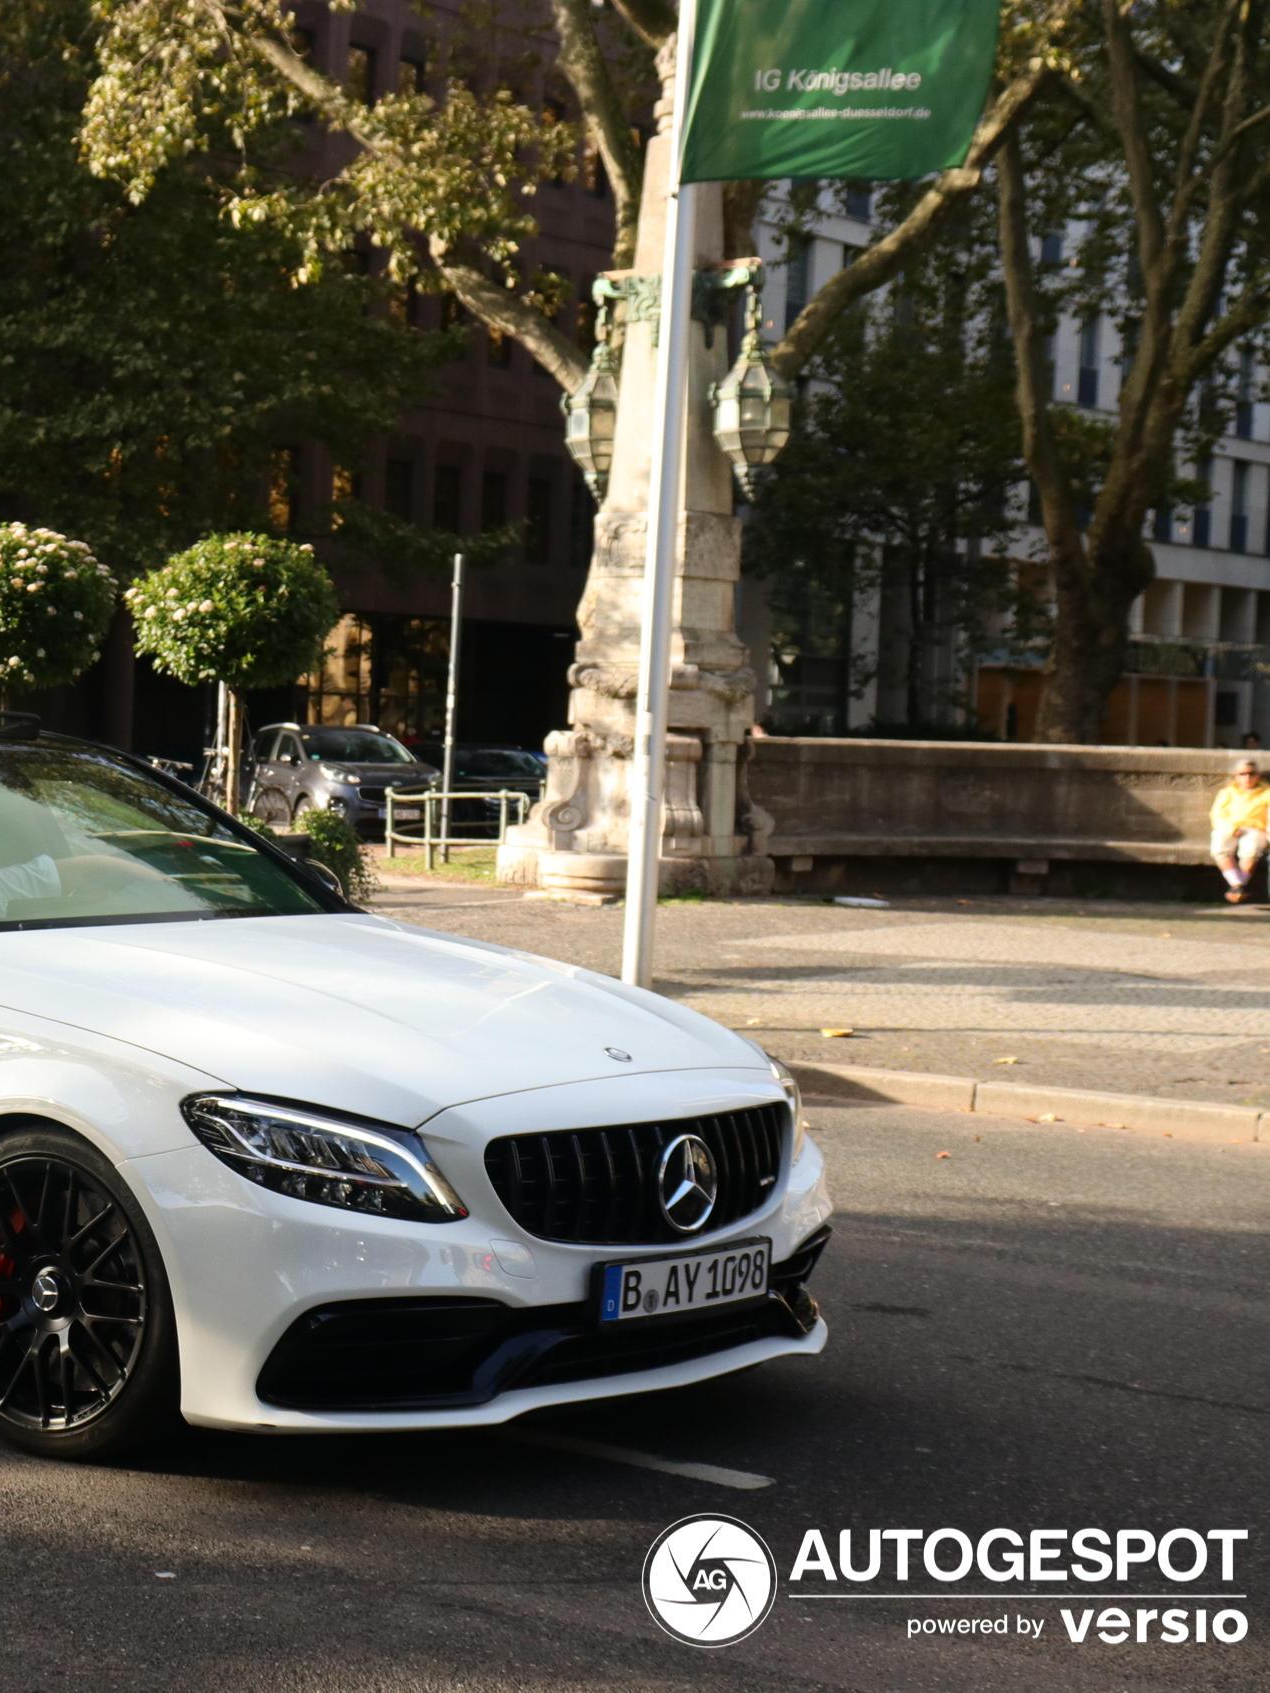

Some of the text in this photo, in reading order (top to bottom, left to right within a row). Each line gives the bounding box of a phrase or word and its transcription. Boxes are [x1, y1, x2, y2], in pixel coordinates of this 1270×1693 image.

[754, 67, 922, 96] IG Königsallee
[740, 106, 932, 121] www.koenigsallee-duesseldorf.de
[622, 1249, 765, 1312] B AY 1098
[606, 1299, 615, 1312] D
